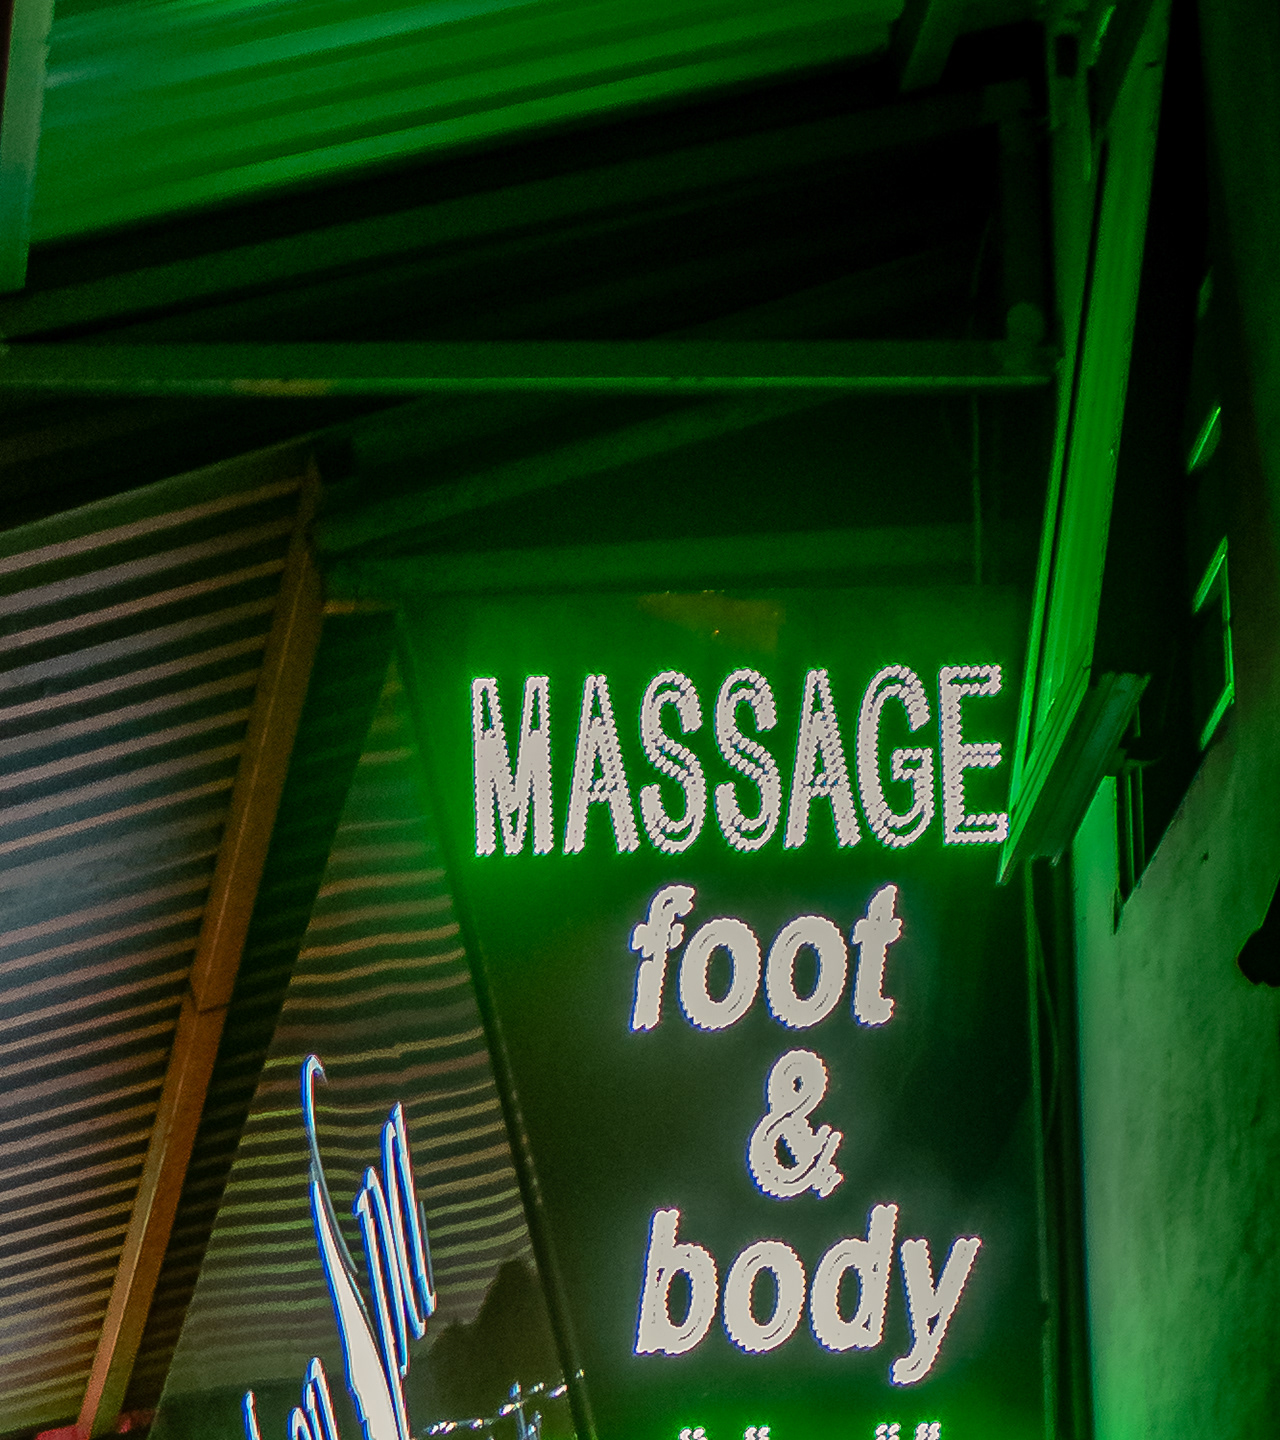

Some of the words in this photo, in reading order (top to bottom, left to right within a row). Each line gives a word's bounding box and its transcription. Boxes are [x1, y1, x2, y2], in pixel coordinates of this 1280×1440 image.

[472, 665, 1007, 856] MASSAGE
[629, 884, 901, 1031] foot
[749, 1049, 842, 1197] &
[635, 1204, 982, 1386] body
